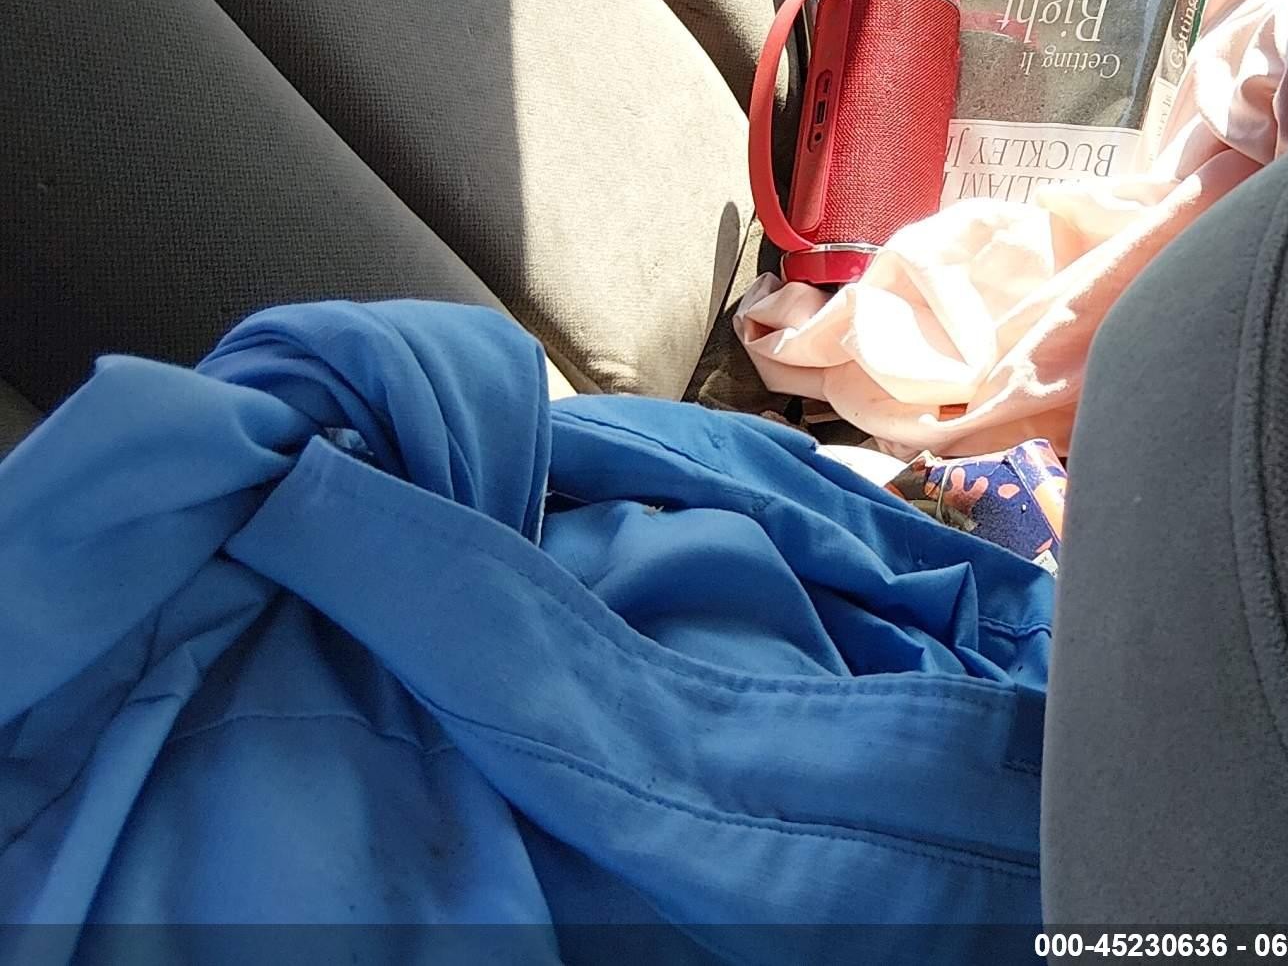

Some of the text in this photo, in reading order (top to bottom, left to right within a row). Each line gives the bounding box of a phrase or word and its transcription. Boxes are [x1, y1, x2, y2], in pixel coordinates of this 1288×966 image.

[1019, 45, 1121, 79] Getting It
[970, 135, 1120, 178] BUCKLEY
